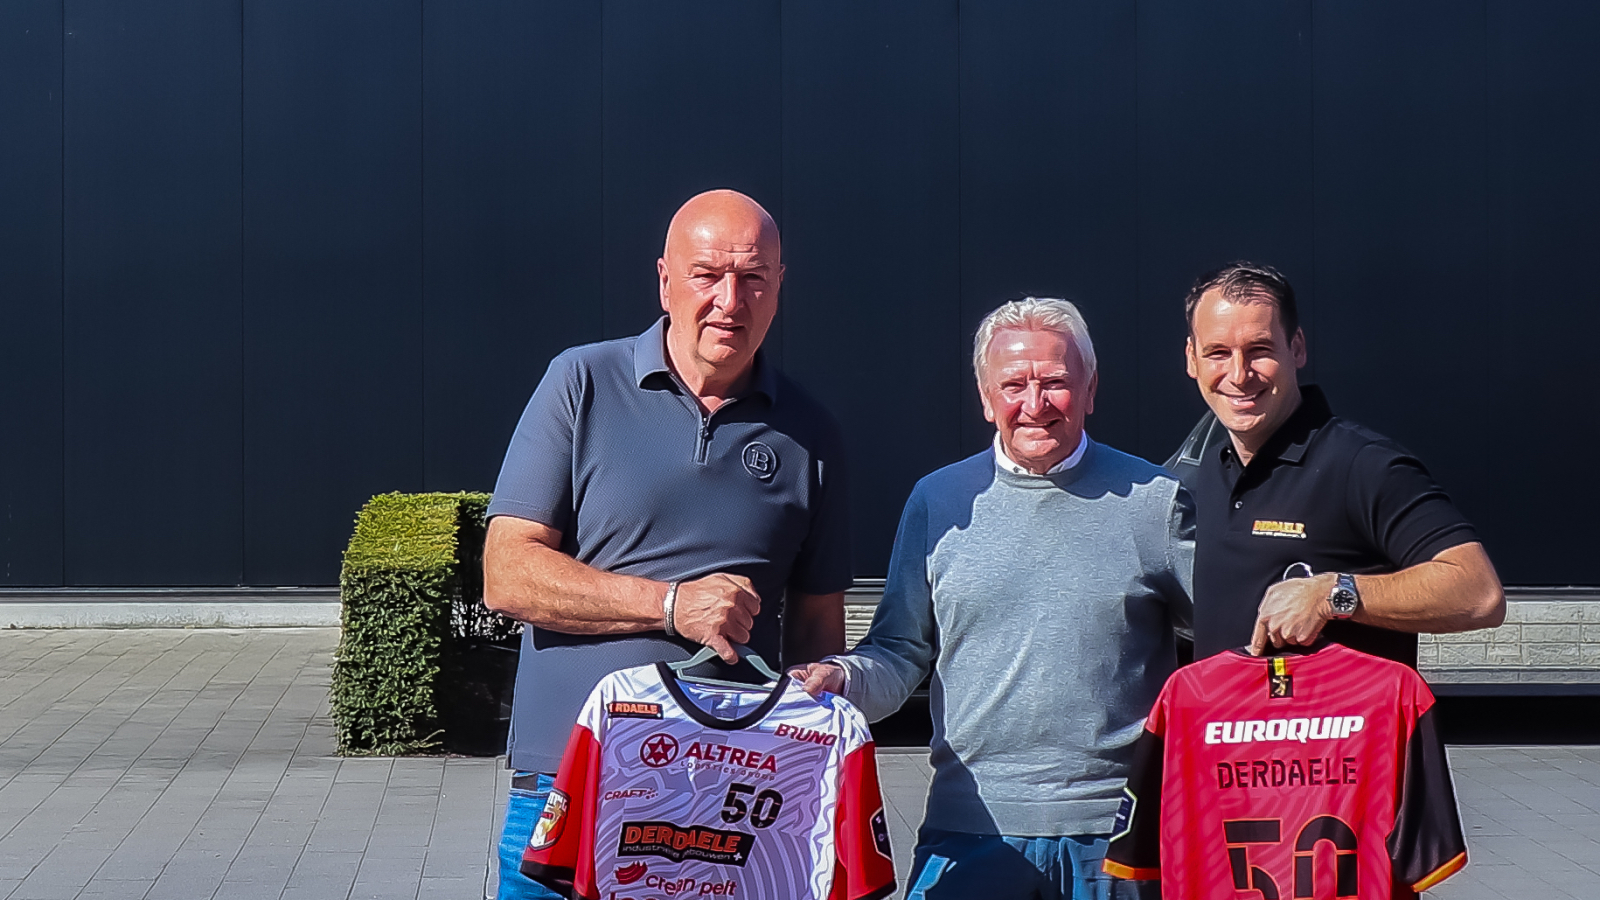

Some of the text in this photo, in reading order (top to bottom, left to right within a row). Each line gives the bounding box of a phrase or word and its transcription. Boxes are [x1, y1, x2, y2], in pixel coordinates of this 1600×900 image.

[774, 723, 838, 746] BRUNO
[1205, 716, 1365, 745] EUROQUIP
[684, 741, 777, 774] ALTREA
[1217, 757, 1358, 789] DERDAELE
[604, 789, 648, 800] CRAFT
[721, 782, 783, 829] 50
[625, 825, 741, 853] DERDAELE
[1221, 813, 1359, 900] 50
[698, 880, 737, 897] pelt
